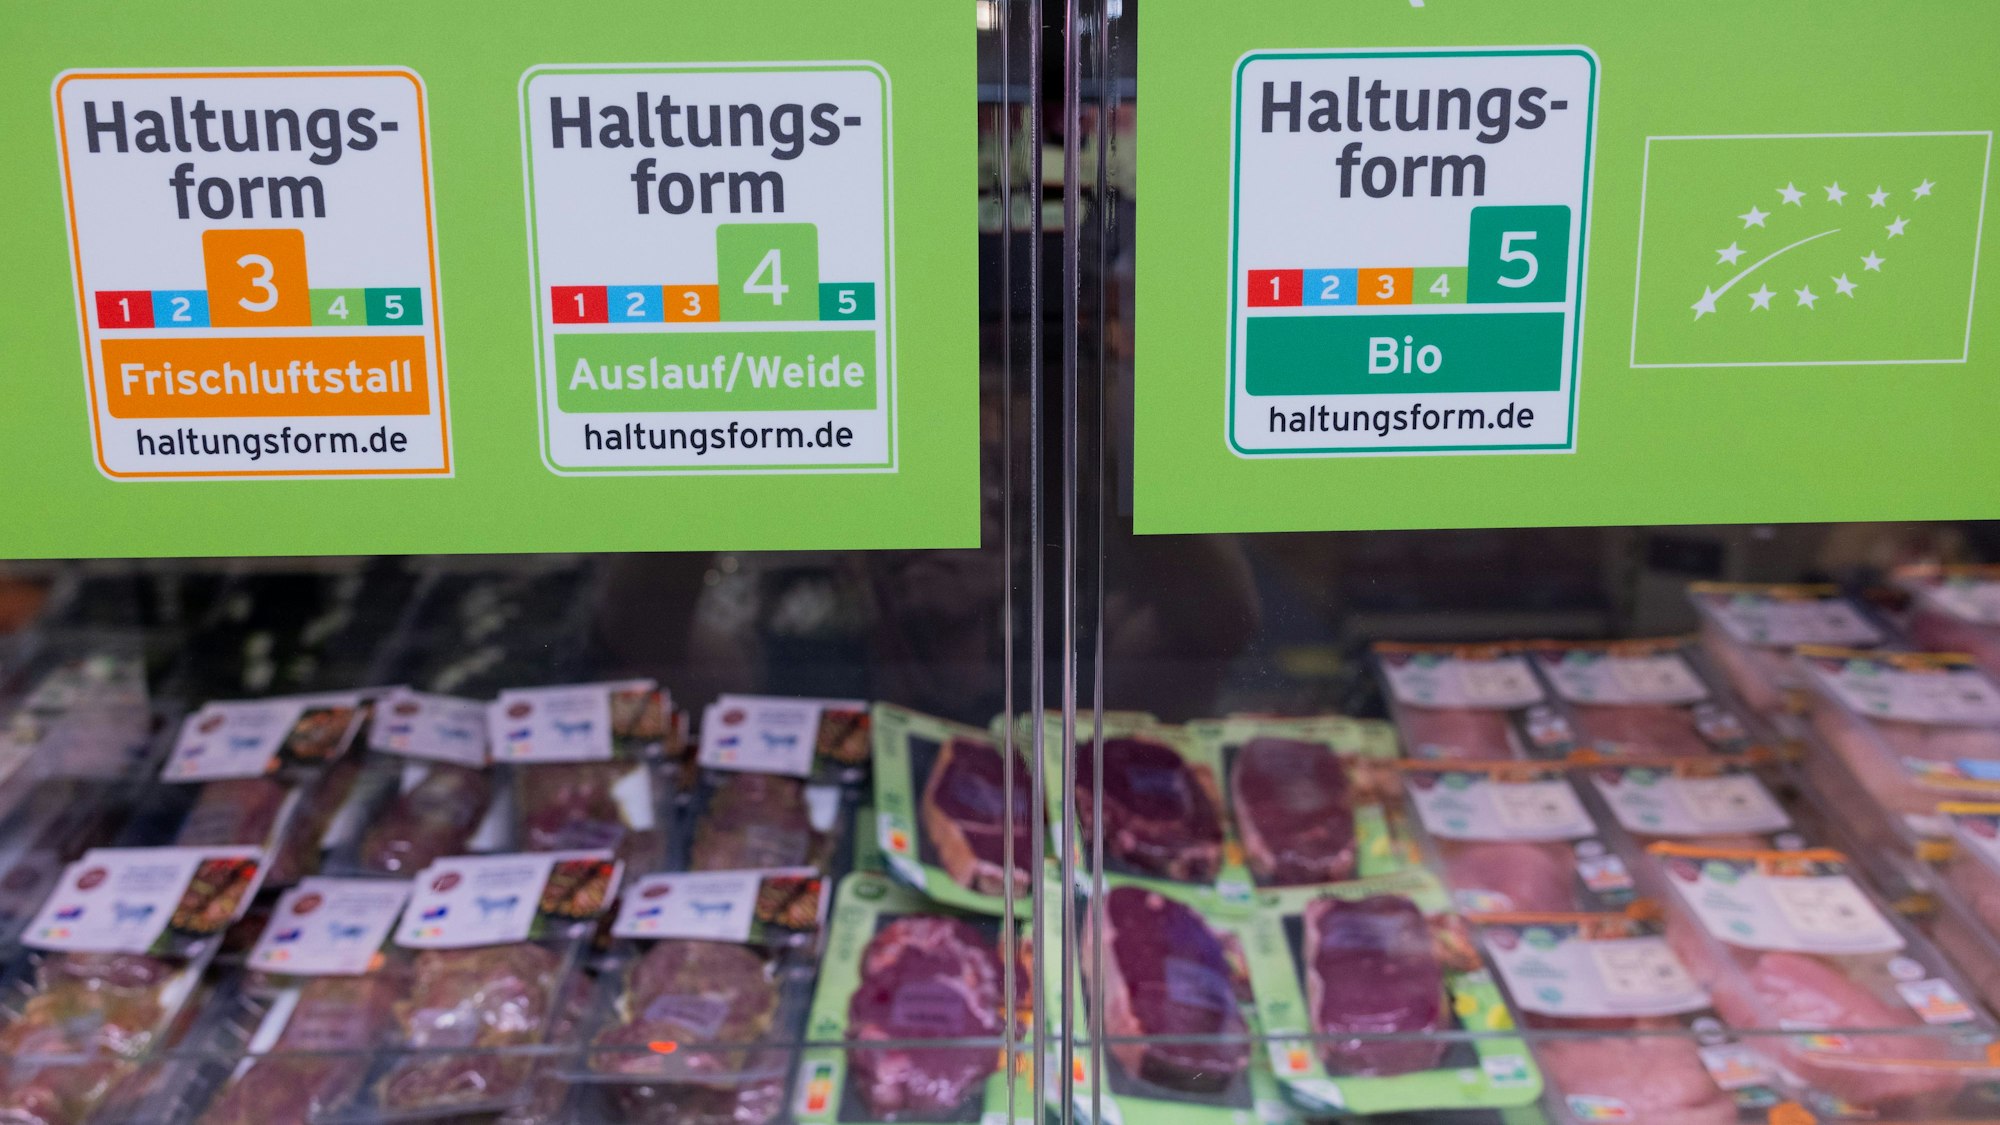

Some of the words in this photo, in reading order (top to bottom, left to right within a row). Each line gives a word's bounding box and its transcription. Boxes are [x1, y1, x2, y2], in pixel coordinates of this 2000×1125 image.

[83, 96, 399, 166] Haltungs-
[549, 91, 862, 161] Haltungs-
[1261, 76, 1568, 145] Haltungs-
[168, 163, 326, 220] form
[630, 157, 785, 215] form
[1335, 141, 1486, 199] form
[118, 297, 131, 323] 1
[170, 296, 192, 322] 2
[236, 253, 279, 313] 3
[327, 295, 350, 320] 4
[385, 294, 405, 320] 5
[573, 292, 585, 318] 1
[626, 291, 646, 317] 2
[682, 291, 702, 317] 3
[742, 248, 790, 306] 4
[838, 289, 857, 315] 5
[1269, 276, 1280, 301] 1
[1320, 274, 1340, 300] 2
[1375, 274, 1395, 300] 3
[1429, 273, 1451, 298] 4
[1496, 230, 1539, 289] 5
[120, 359, 413, 396] Frischluftstall
[568, 351, 865, 393] Auslauf/Weide
[1368, 335, 1443, 375] Bio
[136, 425, 408, 461] haltungsform.de
[584, 420, 853, 456] haltungsform.de
[1269, 401, 1534, 438] haltungsform.de
